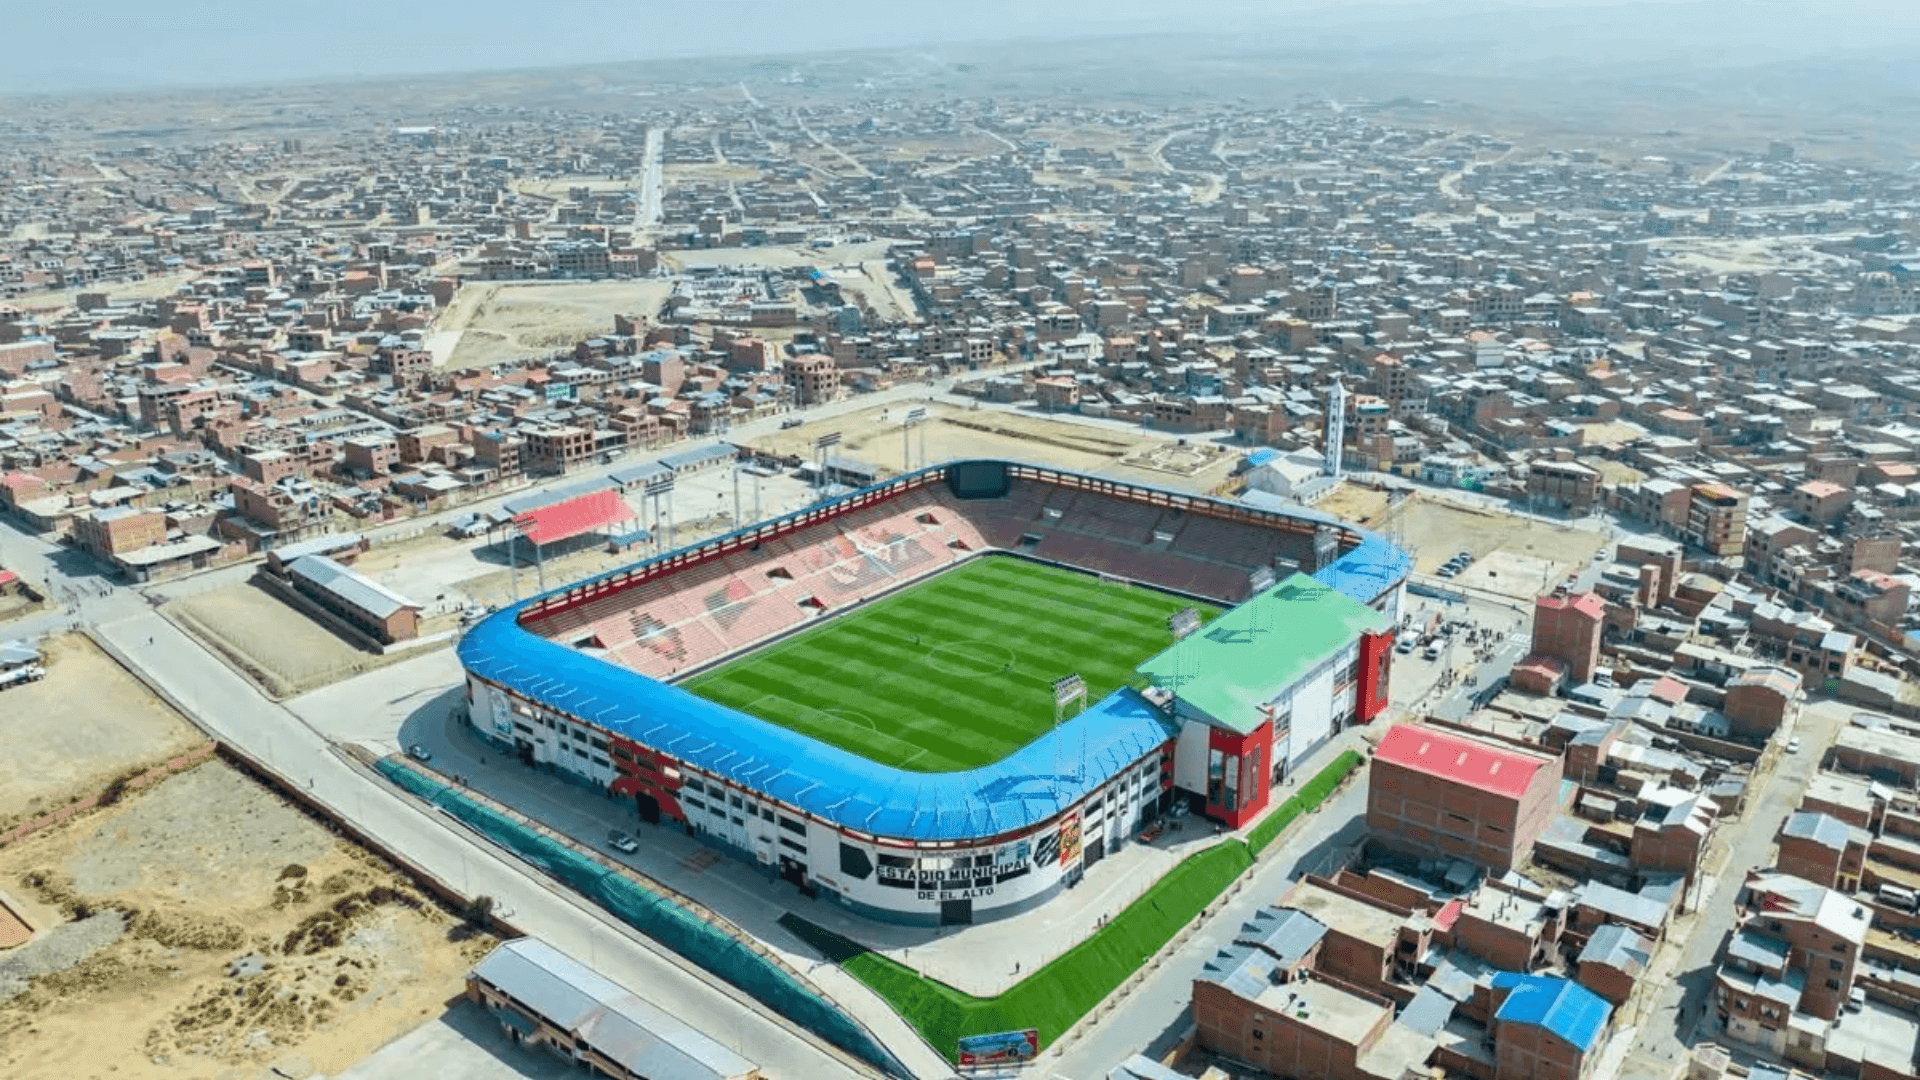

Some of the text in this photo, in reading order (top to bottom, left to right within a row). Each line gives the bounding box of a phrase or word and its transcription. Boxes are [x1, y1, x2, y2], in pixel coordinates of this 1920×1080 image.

[876, 858, 1031, 881] ESTADIO MUNICIPAL
[918, 887, 994, 900] DE EL ALTO
